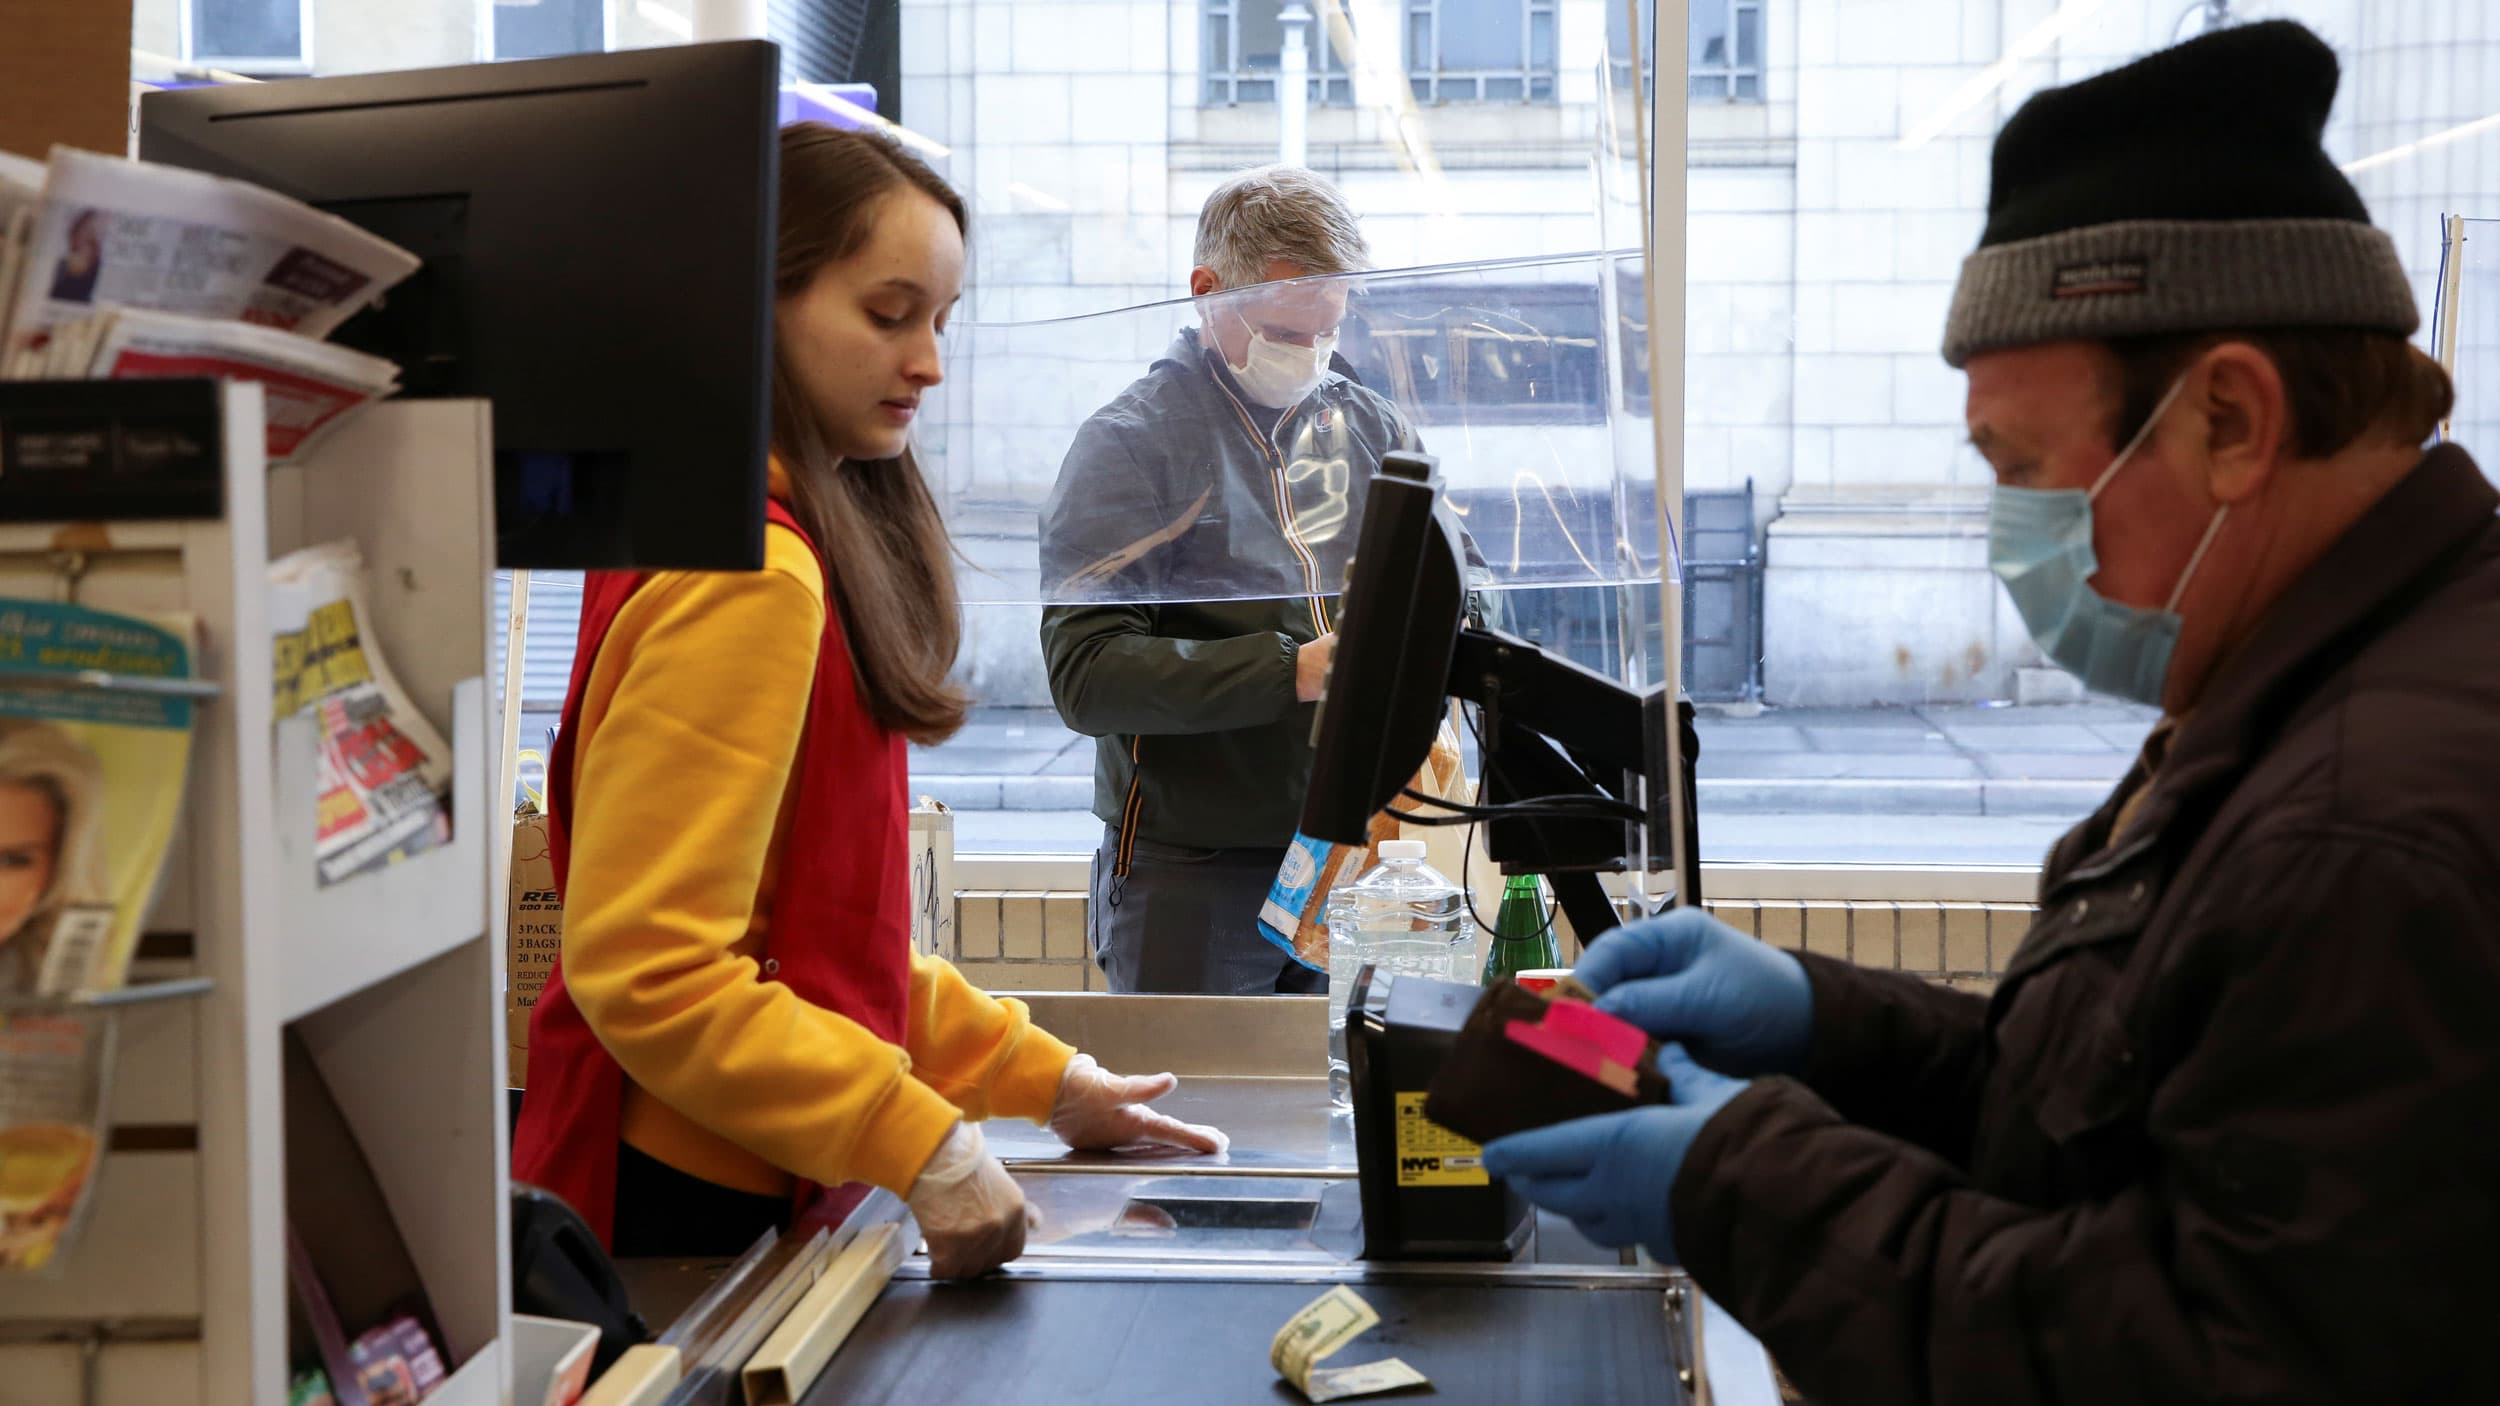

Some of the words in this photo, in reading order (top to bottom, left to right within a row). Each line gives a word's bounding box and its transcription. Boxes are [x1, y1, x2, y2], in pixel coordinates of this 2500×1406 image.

[521, 891, 559, 902] RE
[518, 924, 524, 935] 3
[526, 924, 557, 935] PACK
[517, 938, 524, 949] 3
[526, 938, 556, 949] BAGS
[518, 953, 529, 963] 20
[1401, 1157, 1441, 1171] NYC
